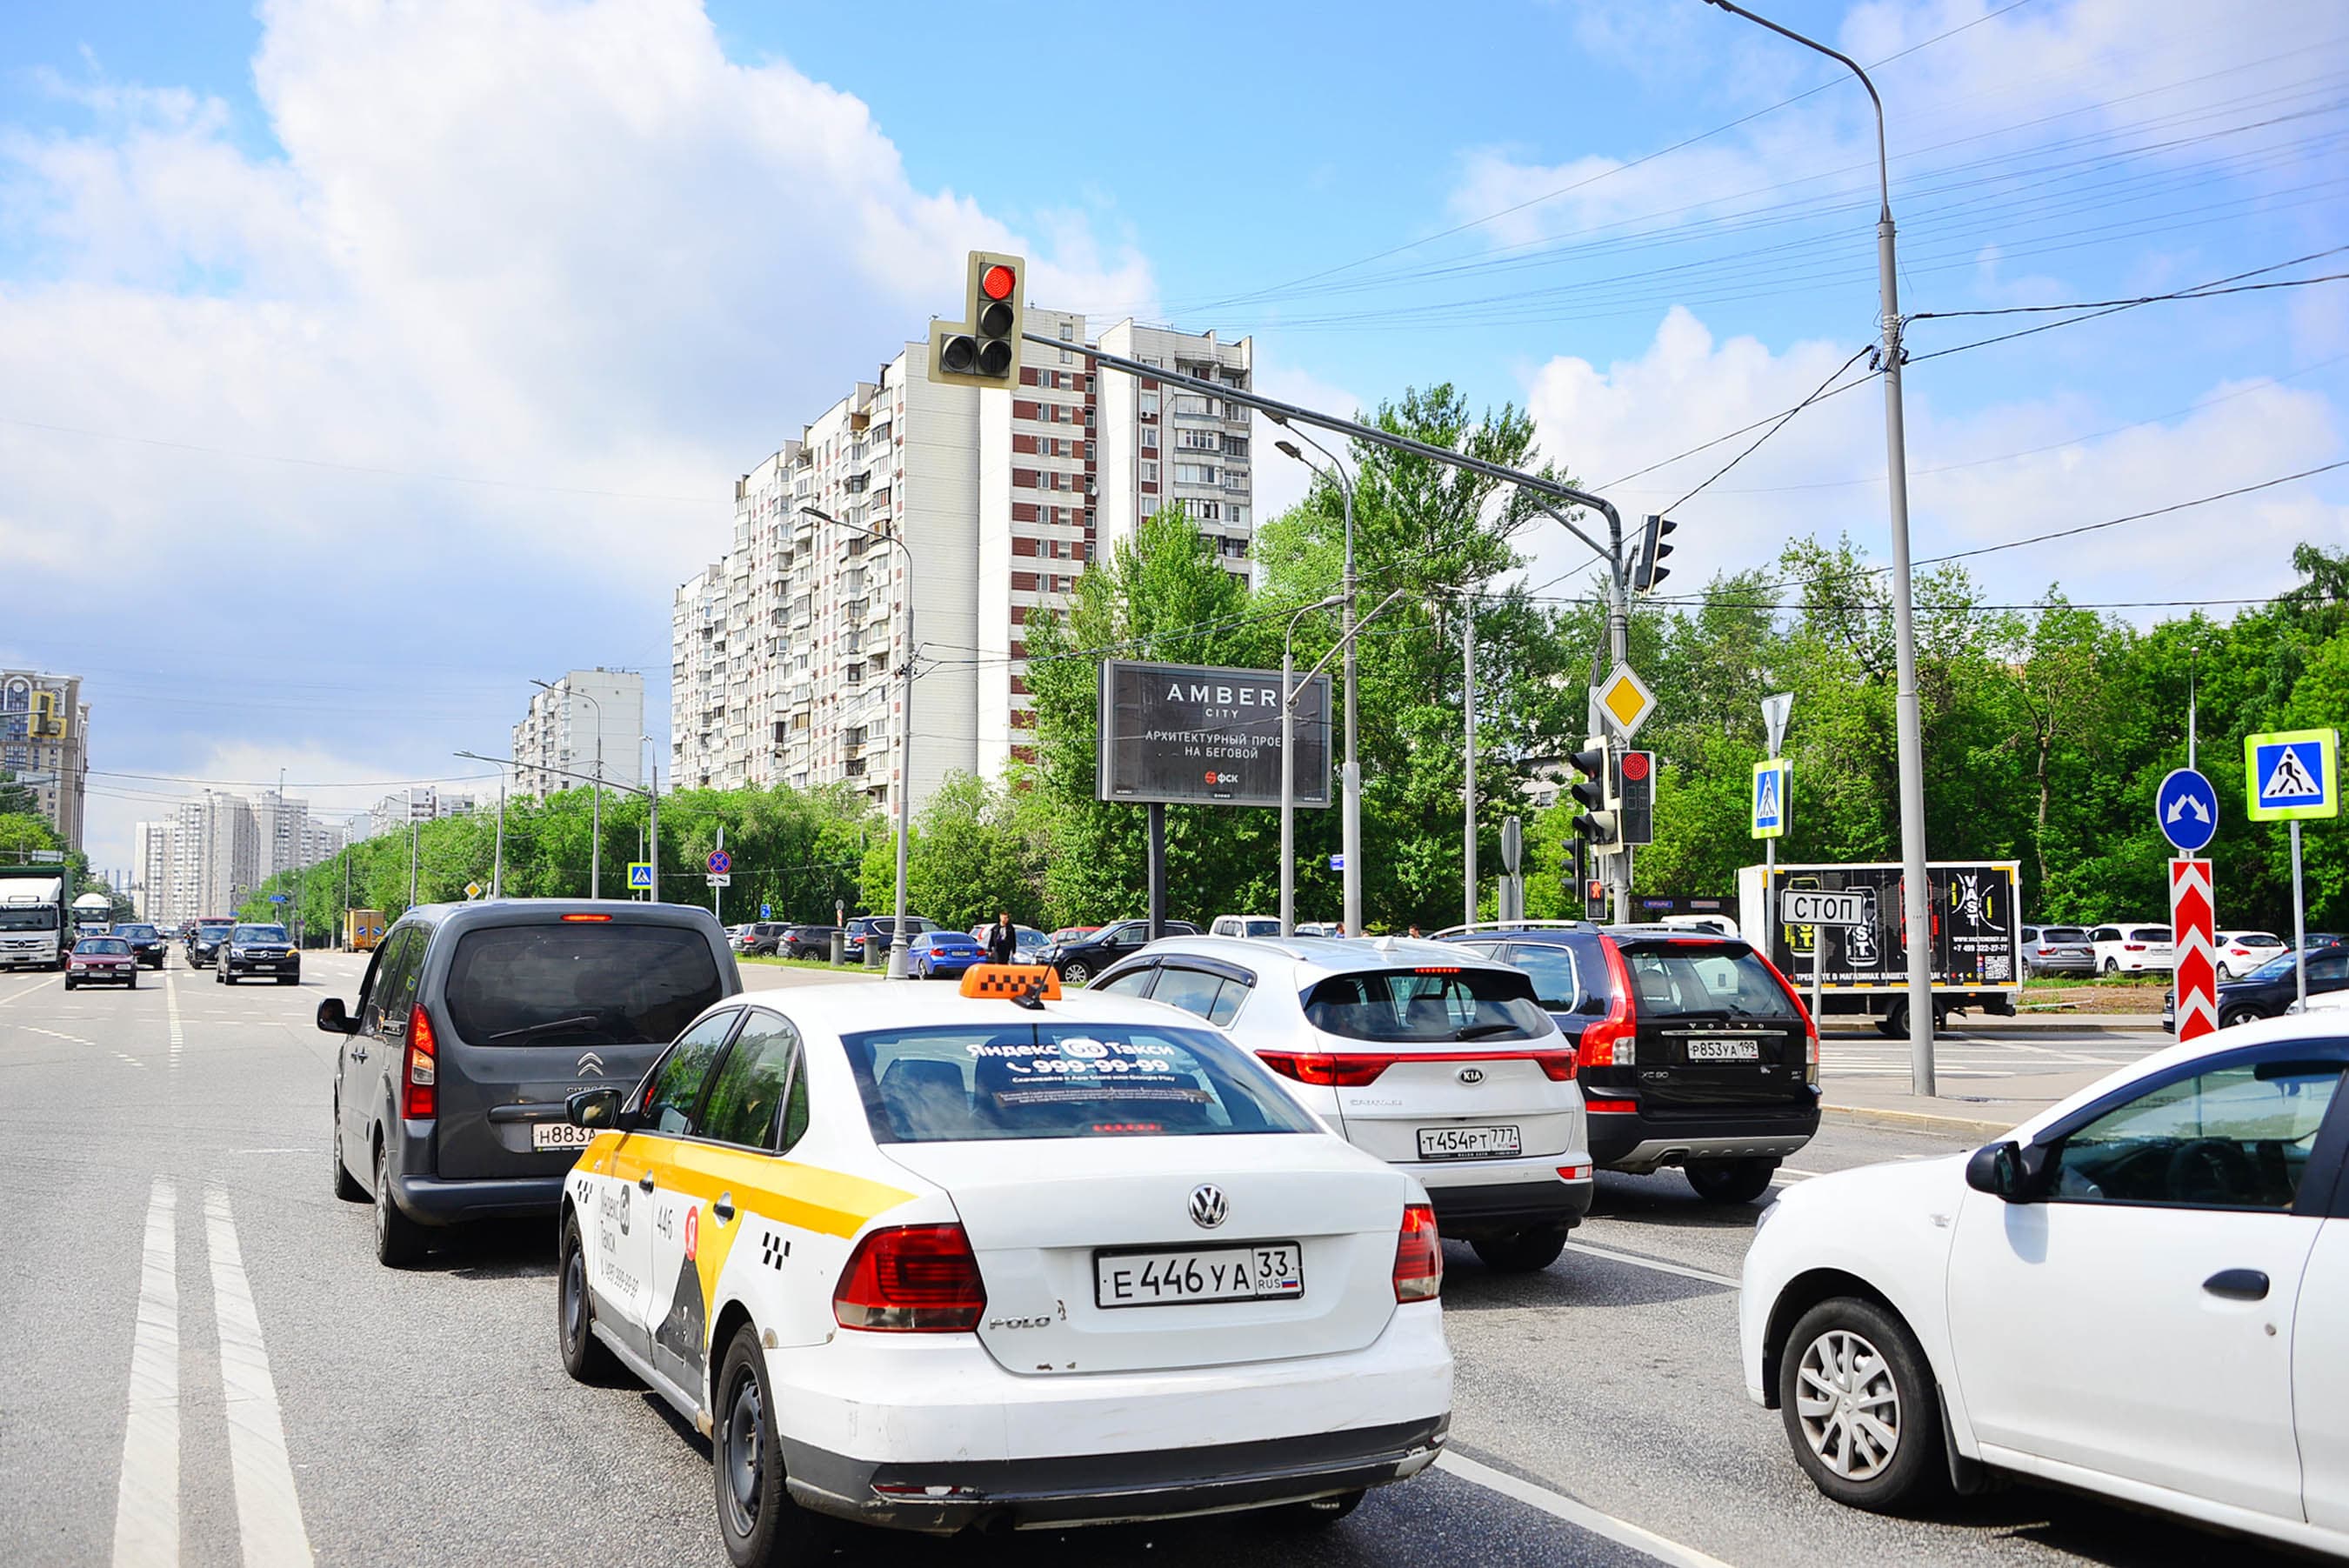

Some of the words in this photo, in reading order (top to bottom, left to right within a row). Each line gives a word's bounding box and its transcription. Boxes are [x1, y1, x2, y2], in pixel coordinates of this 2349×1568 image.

[1167, 684, 1277, 707] AMBER
[1205, 708, 1239, 719] CITY
[1145, 731, 1246, 746] АРХИТЕКТУРНЫЙ
[1252, 736, 1281, 748] ПРОЕ
[1185, 747, 1201, 757] НА
[1206, 748, 1258, 759] БЕГОВОЙ
[1218, 772, 1238, 784] ФСК
[1794, 897, 1852, 920] СТОП
[1796, 972, 1831, 982] ТРЕБТЕ
[966, 1044, 1060, 1058] Яндекс
[1106, 1042, 1174, 1056] Такси
[1692, 1043, 1738, 1058] Р853УА
[1738, 1042, 1756, 1053] 199
[1031, 1059, 1170, 1073] 999-99-99
[1463, 1071, 1482, 1083] KIA
[539, 1126, 597, 1144] Н883А
[1425, 1131, 1487, 1151] Т454РТ
[1491, 1129, 1513, 1143] 777
[657, 1204, 674, 1241] 446
[1113, 1258, 1251, 1299] Е446УА
[1258, 1251, 1289, 1278] 33
[1258, 1278, 1281, 1289] RUS
[990, 1314, 1051, 1331] POLO
